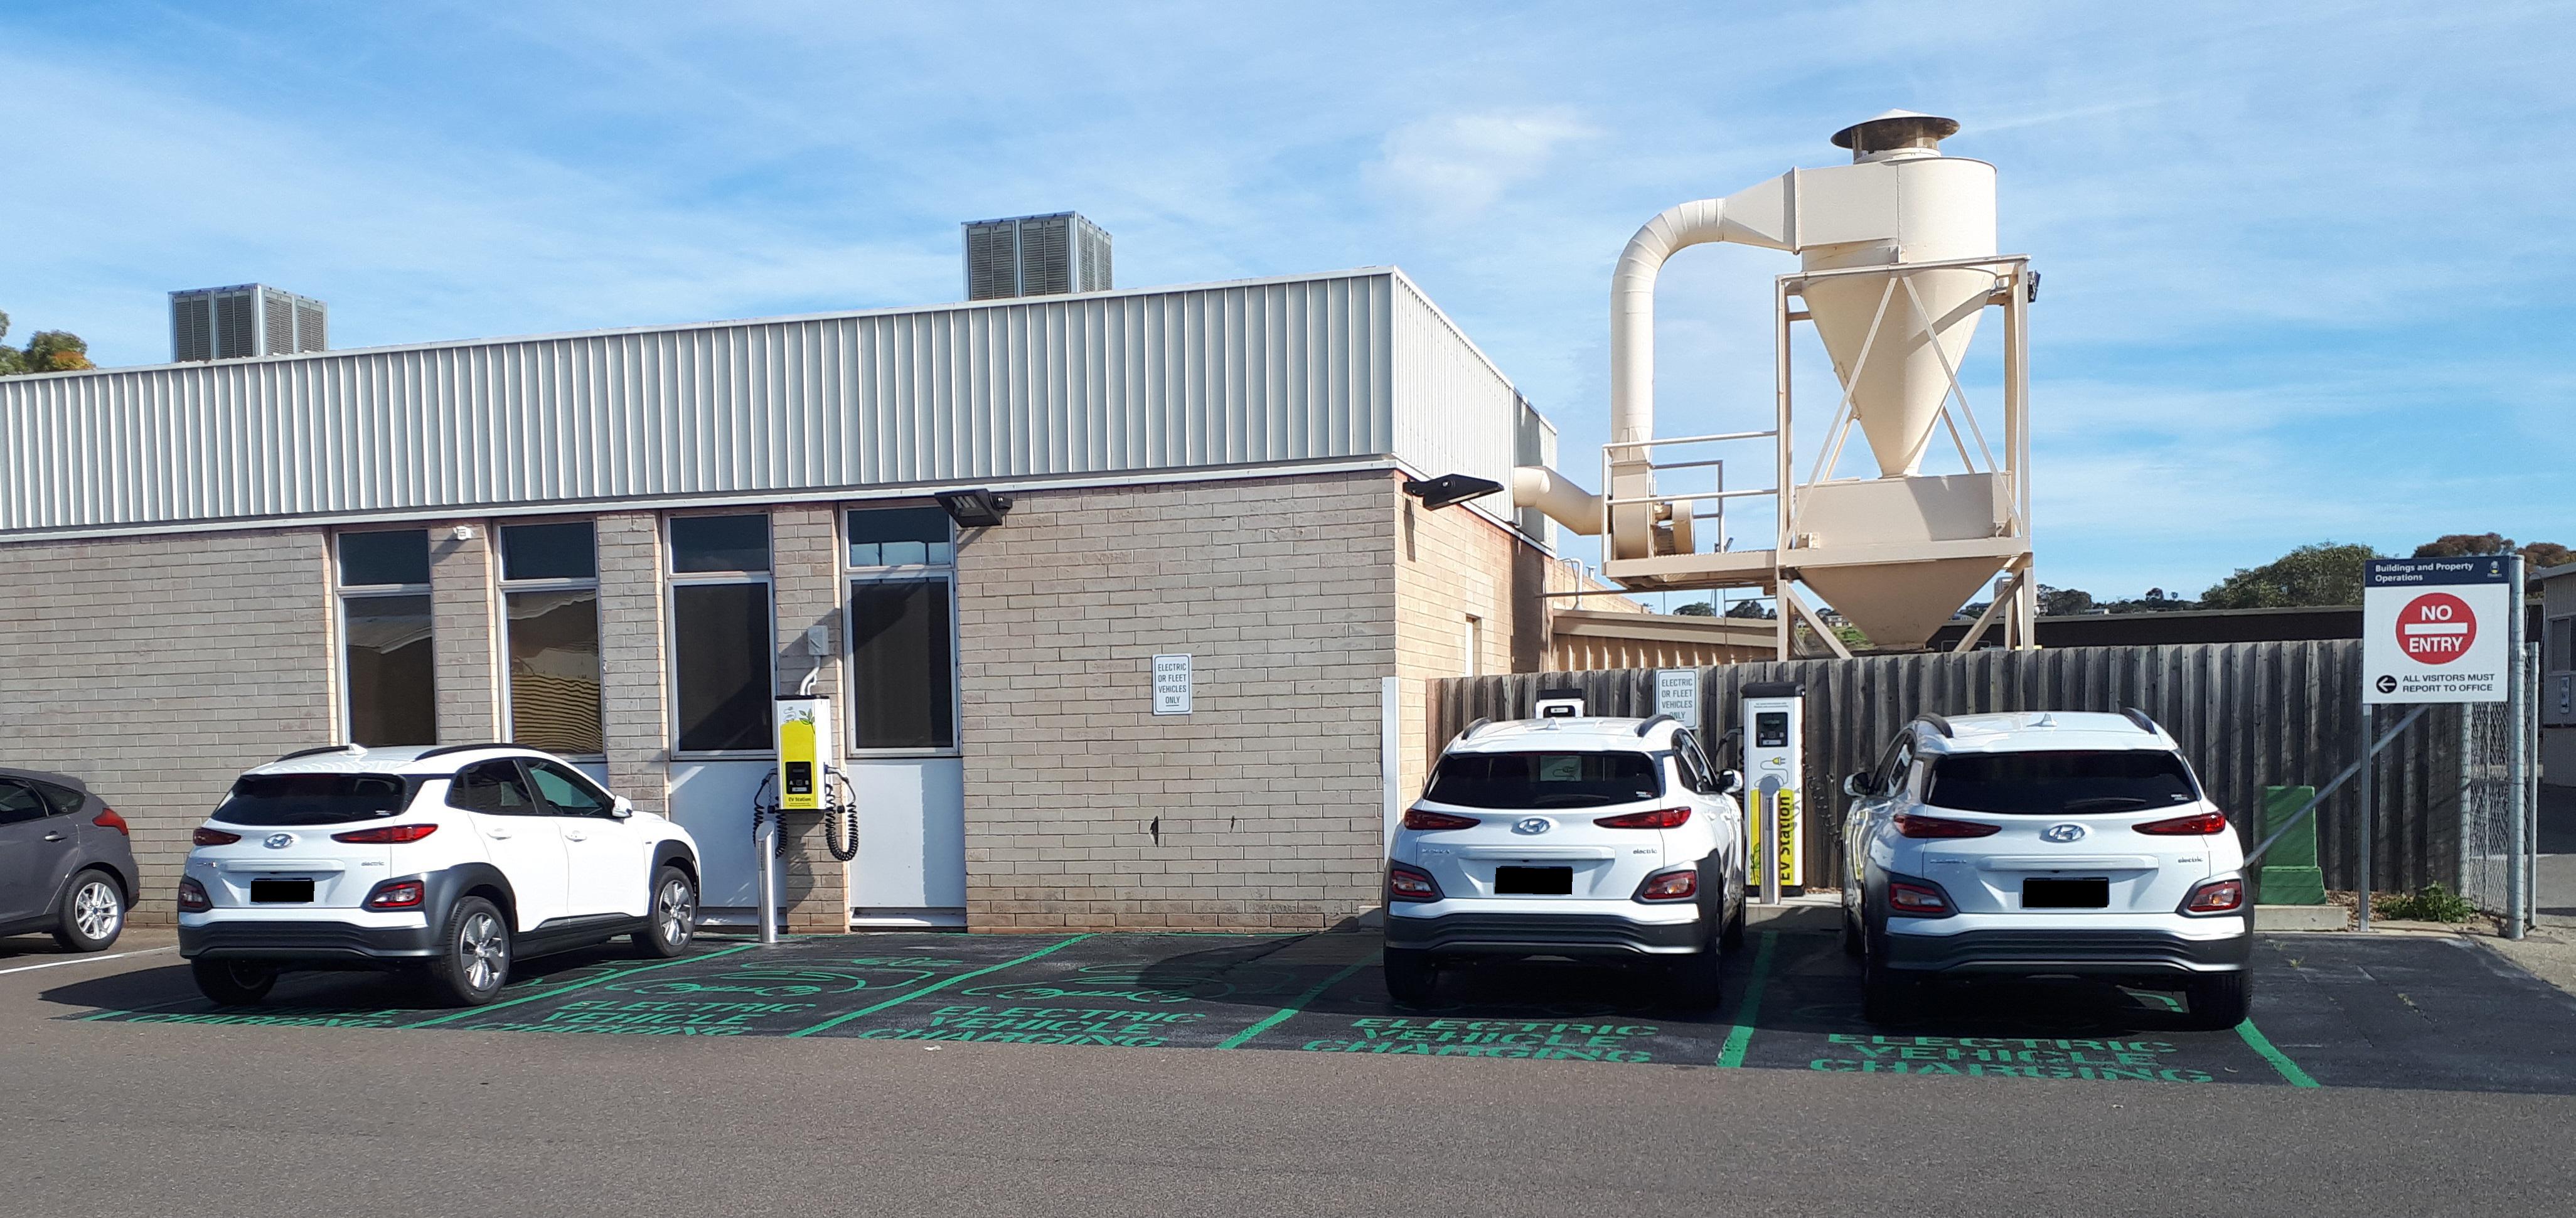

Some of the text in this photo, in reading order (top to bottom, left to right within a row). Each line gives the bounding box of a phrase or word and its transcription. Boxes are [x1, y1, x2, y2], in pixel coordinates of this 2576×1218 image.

[2375, 564, 2415, 572] Buildings
[2436, 563, 2474, 571] Property
[2375, 574, 2423, 584] Operations
[2421, 605, 2452, 621] NO
[2409, 637, 2463, 653] ENTRY
[1158, 663, 1186, 671] ELECTRIC
[1168, 674, 1186, 682] FLEET
[1662, 678, 1692, 687] ELECTRIC
[1662, 700, 1692, 708] VEHICLES
[1670, 711, 1686, 719] ONLY
[1780, 796, 1790, 880] EV Station
[556, 1000, 818, 1013] ELECTRIC
[931, 1006, 1206, 1022] ELECTRIC
[542, 1012, 766, 1025] VEHICLE
[931, 1016, 1167, 1034] VEHICLE
[1351, 1018, 1659, 1036] ELECTRIC
[858, 1027, 1171, 1047] CHARGING
[1362, 1027, 1628, 1049] VEHICLE
[1827, 1032, 2178, 1053] ELECTRIC
[1301, 1039, 1653, 1063] CHARGING
[1849, 1044, 2160, 1068] VEHICLE
[1809, 1057, 2216, 1083] CHARGING
